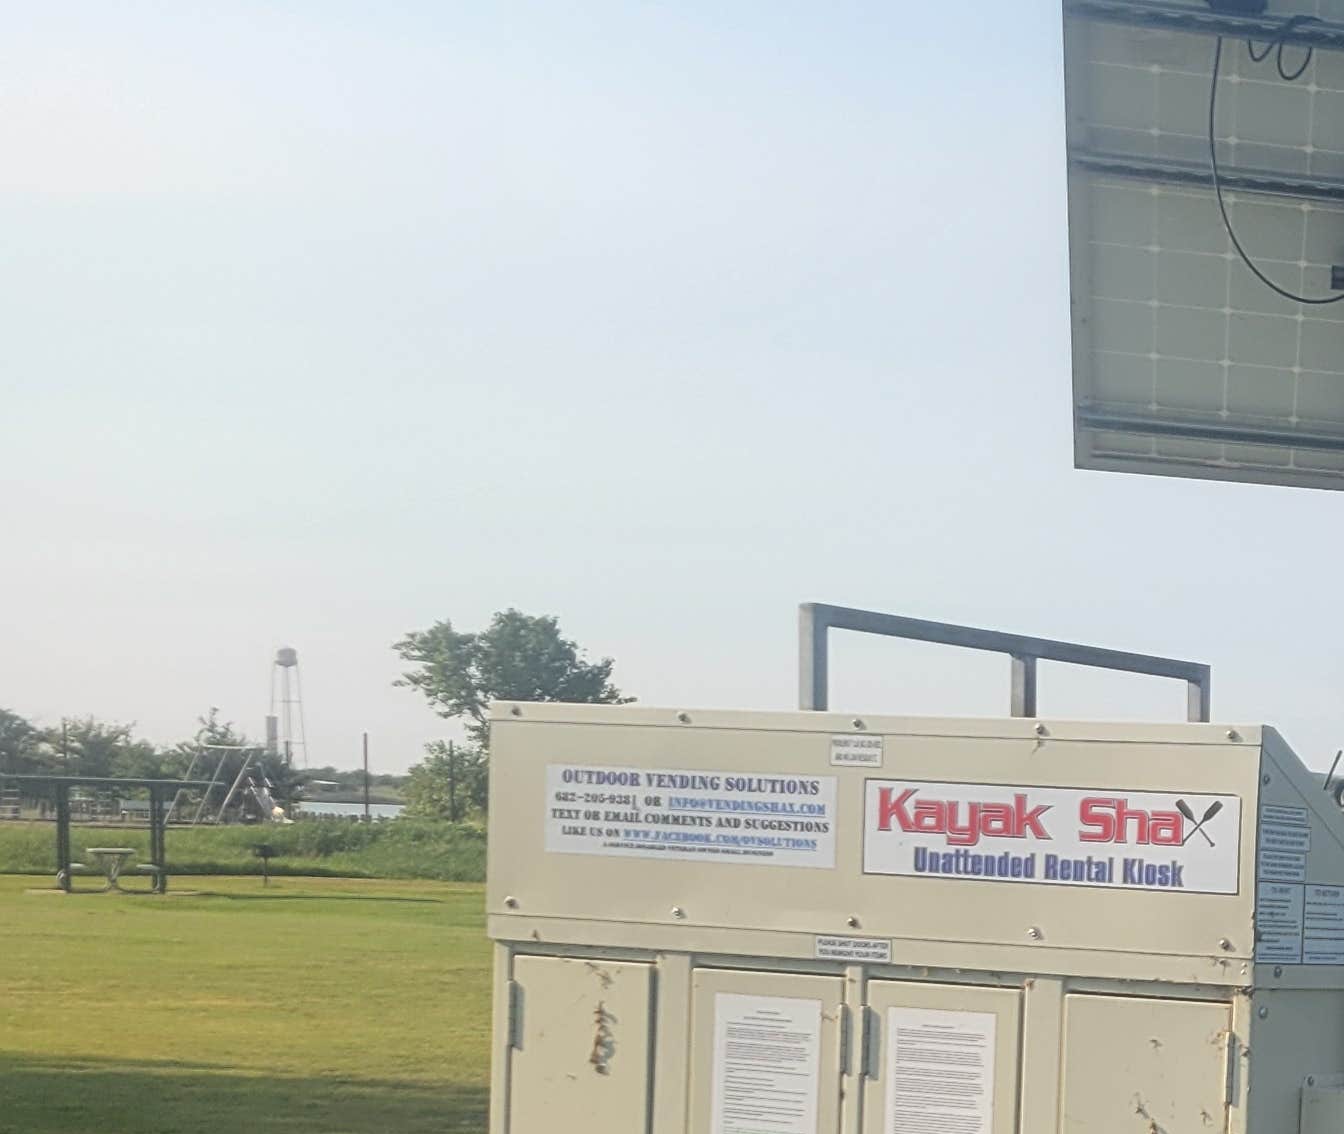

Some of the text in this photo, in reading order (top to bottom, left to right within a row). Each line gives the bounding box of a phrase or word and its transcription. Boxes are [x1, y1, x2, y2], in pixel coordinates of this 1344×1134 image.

[562, 769, 820, 796] OUTDOOR VENDING SOLUTIONS
[644, 796, 662, 808] OR
[551, 808, 829, 834] TEXT OR EMAIL COMMENTS AND SUGGESTIONS
[877, 787, 1053, 846] Kayak
[562, 825, 588, 837] LIKE
[590, 826, 604, 837] US
[606, 827, 620, 838] ON
[914, 846, 1185, 888] Unattended Rental Kiosk
